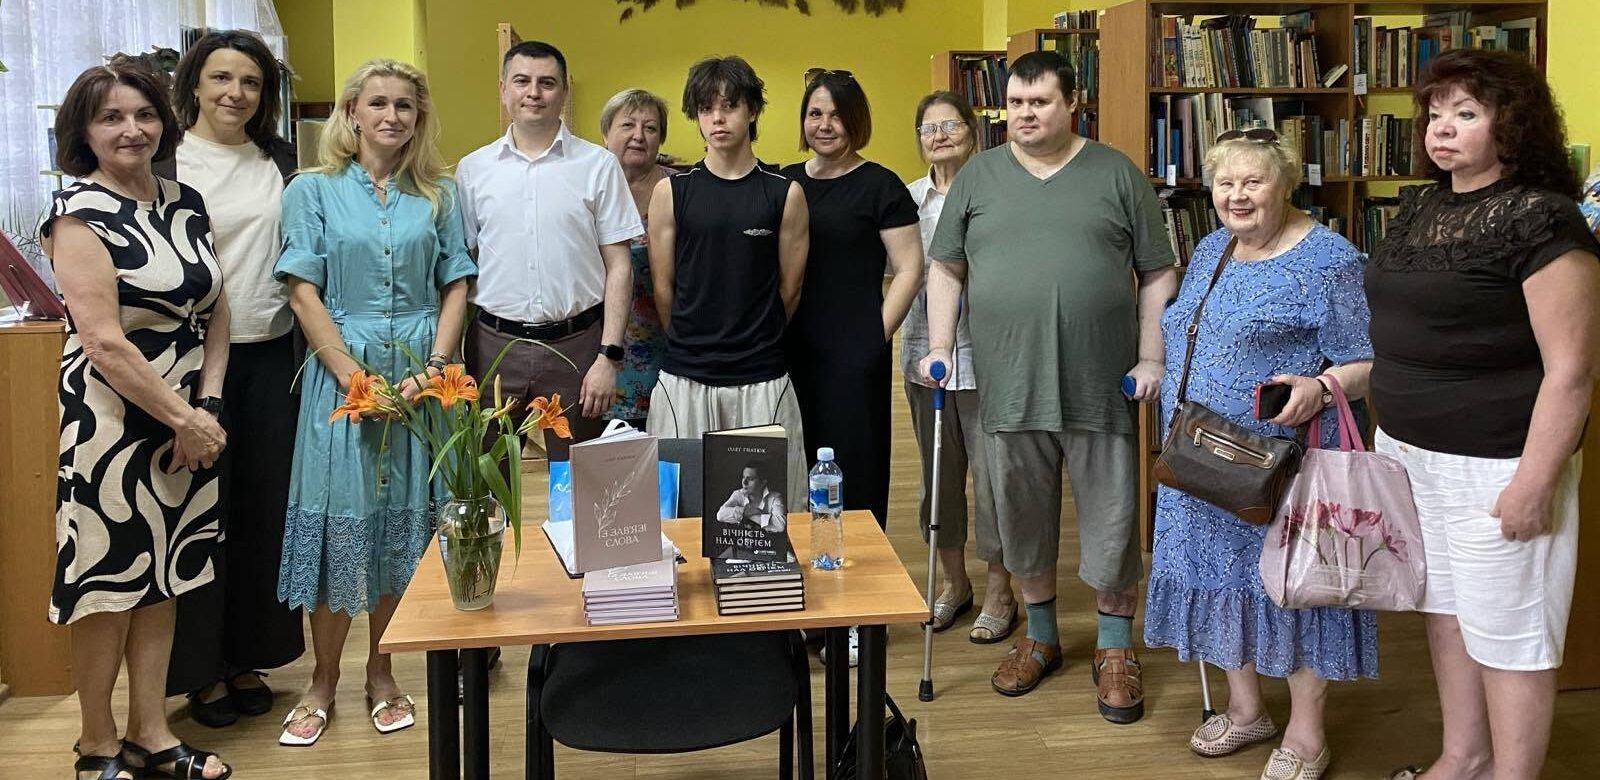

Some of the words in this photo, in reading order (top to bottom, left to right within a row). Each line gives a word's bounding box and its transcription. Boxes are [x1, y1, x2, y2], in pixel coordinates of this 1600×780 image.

[722, 528, 765, 538] ВІЧНІСТЬ
[605, 535, 640, 548] СЛОВА
[715, 536, 734, 545] НАД
